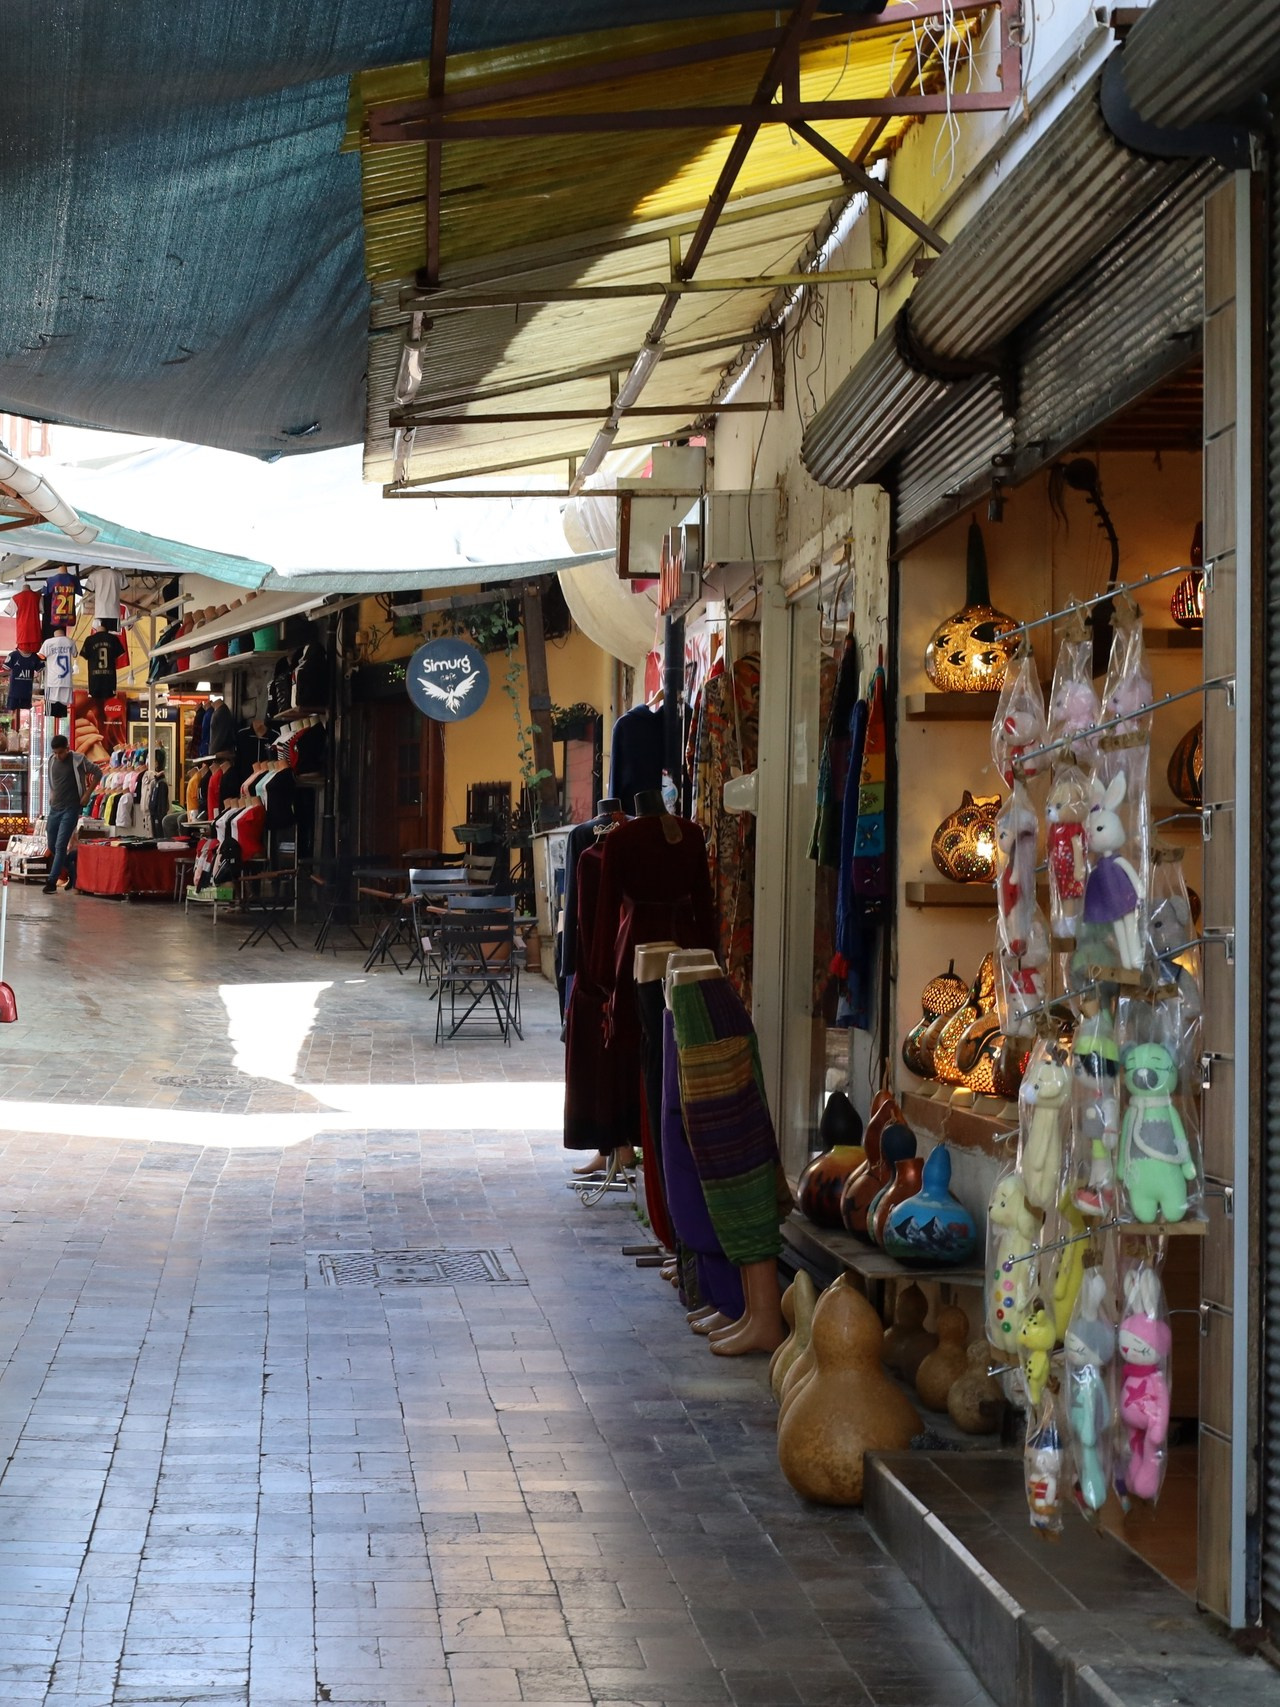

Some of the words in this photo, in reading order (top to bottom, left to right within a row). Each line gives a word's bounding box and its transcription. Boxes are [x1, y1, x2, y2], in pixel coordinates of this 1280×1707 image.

[56, 594, 74, 614] 21
[57, 655, 69, 678] 9
[97, 647, 108, 669] 9
[139, 708, 168, 719] Ekli
